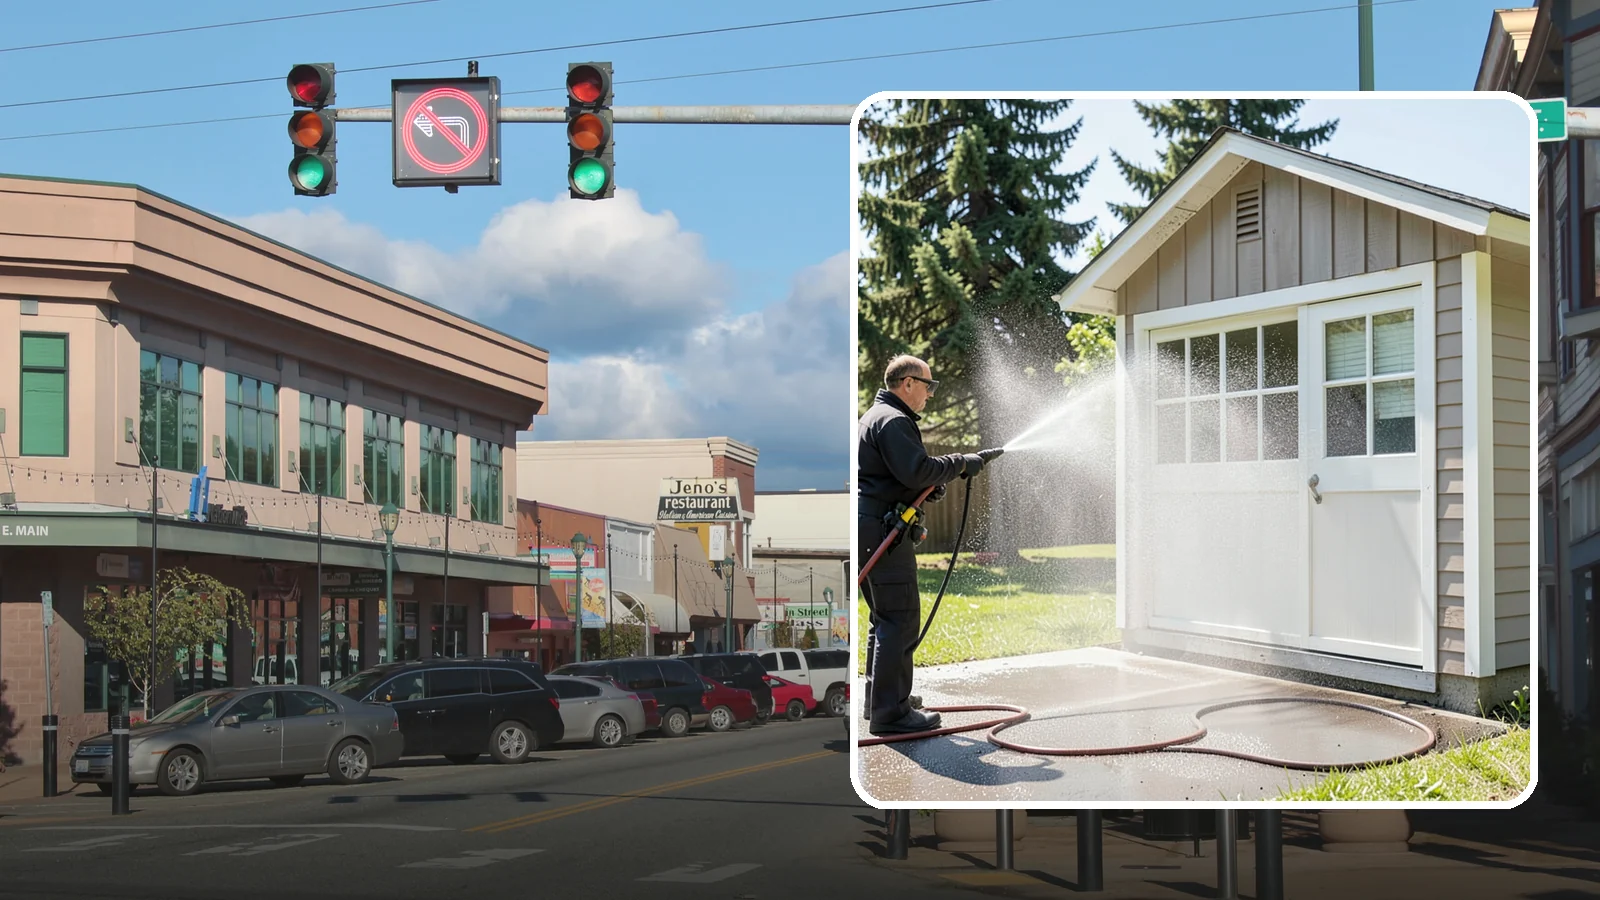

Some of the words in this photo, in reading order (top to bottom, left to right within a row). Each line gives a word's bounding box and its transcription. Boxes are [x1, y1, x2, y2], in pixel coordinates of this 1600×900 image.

[669, 480, 728, 494] Jeno's
[665, 496, 731, 509] restaurant
[658, 510, 682, 520] Italian
[686, 510, 715, 519] American
[715, 509, 737, 519] Cuisine
[2, 525, 13, 536] E.
[15, 525, 49, 536] MAIN
[786, 607, 795, 616] in
[797, 607, 829, 617] Street
